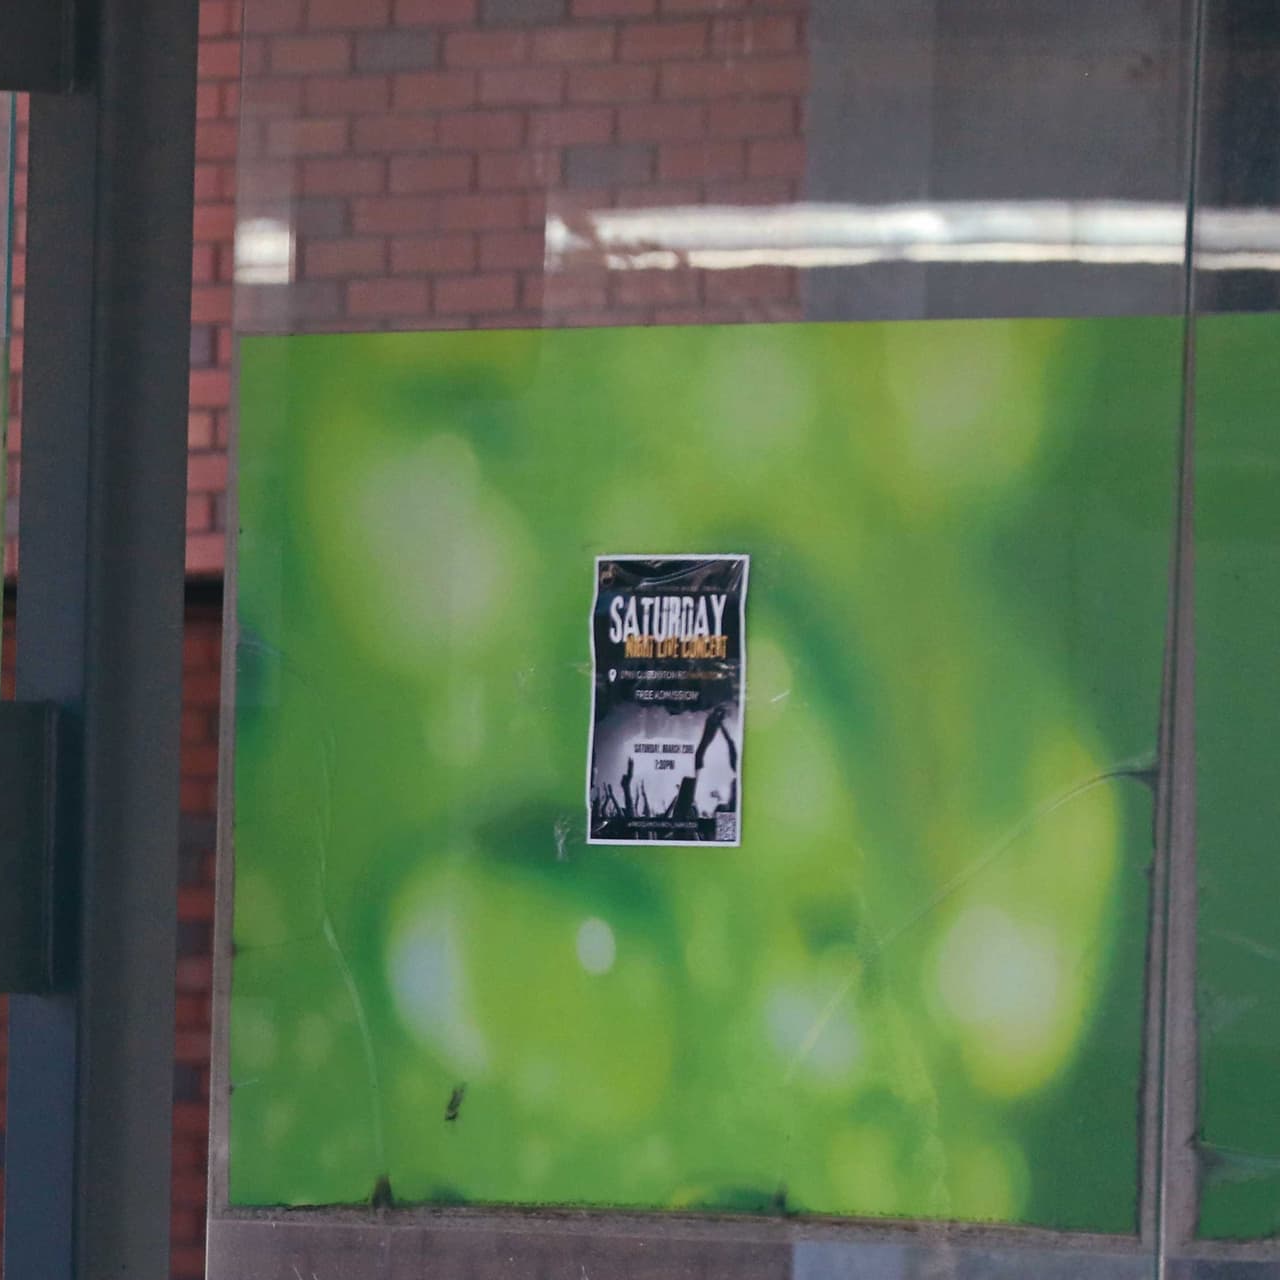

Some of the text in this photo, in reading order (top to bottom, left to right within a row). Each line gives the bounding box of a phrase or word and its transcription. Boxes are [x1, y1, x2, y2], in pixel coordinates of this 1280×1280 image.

[609, 595, 727, 643] SATURDAY
[625, 635, 728, 659] NIGHT LIVE CONCERT
[635, 690, 654, 700] FREE
